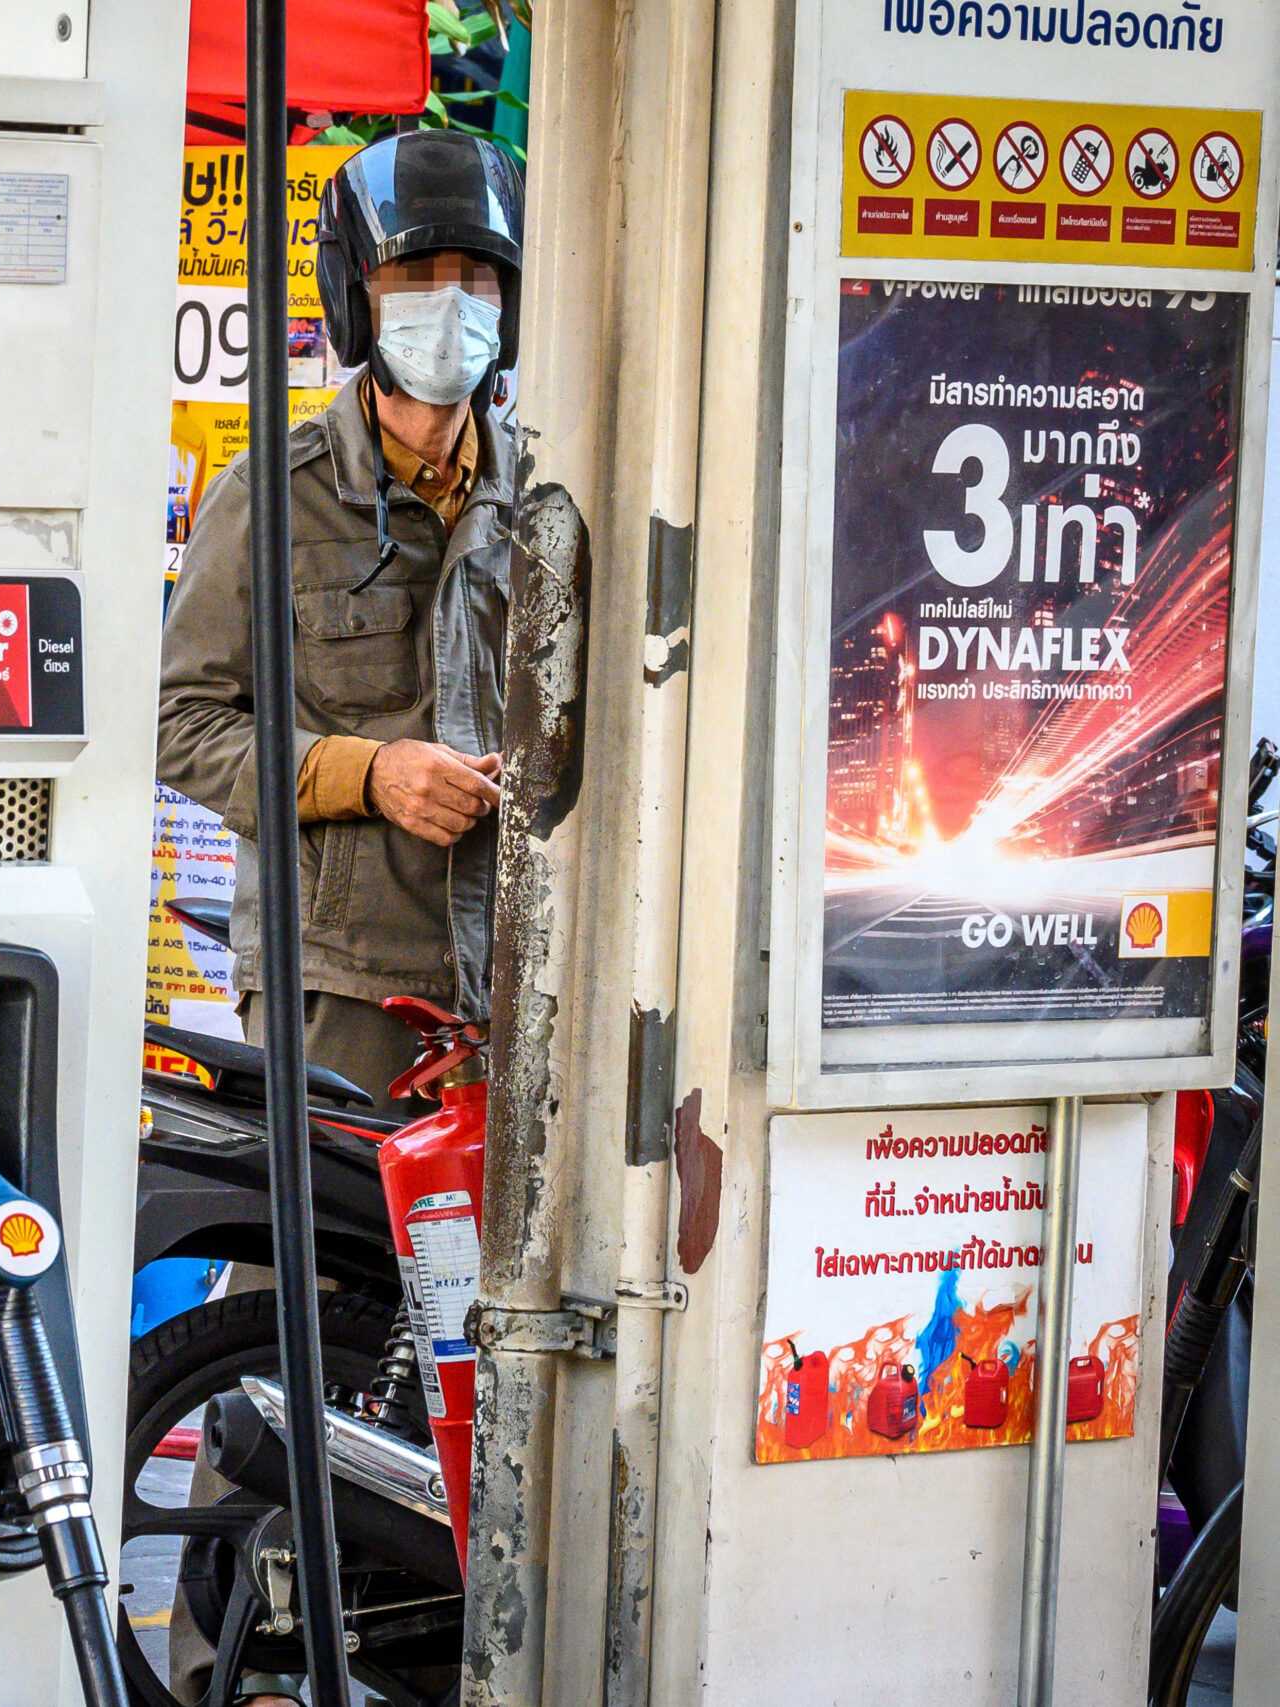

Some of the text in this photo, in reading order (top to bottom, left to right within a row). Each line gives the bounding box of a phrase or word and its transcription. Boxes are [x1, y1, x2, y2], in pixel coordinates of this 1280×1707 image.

[883, 0, 1223, 53] เพอความปลอดภัย
[1018, 284, 1153, 308] แกสโซฮอล
[929, 373, 1145, 411] มีสารทำความสะอาด
[1023, 419, 1142, 466] มากถึง
[923, 424, 1014, 587] 3
[920, 597, 1013, 619] เทคโนโลยีใหม่
[38, 637, 74, 654] Diesel
[919, 626, 1131, 671] DYNAFLEX
[917, 678, 1132, 701] แรงกว่า ประสิทธิภาพมากกว่า
[162, 872, 182, 881] AX7
[187, 874, 226, 886] 10w-40
[163, 938, 183, 949] AX5
[961, 913, 1098, 948] GO WELL
[164, 966, 183, 976] AX5
[203, 969, 227, 979] AX5
[815, 1235, 1093, 1277] ใส่เฉพาะภาชนะที่ได้มาตาน
